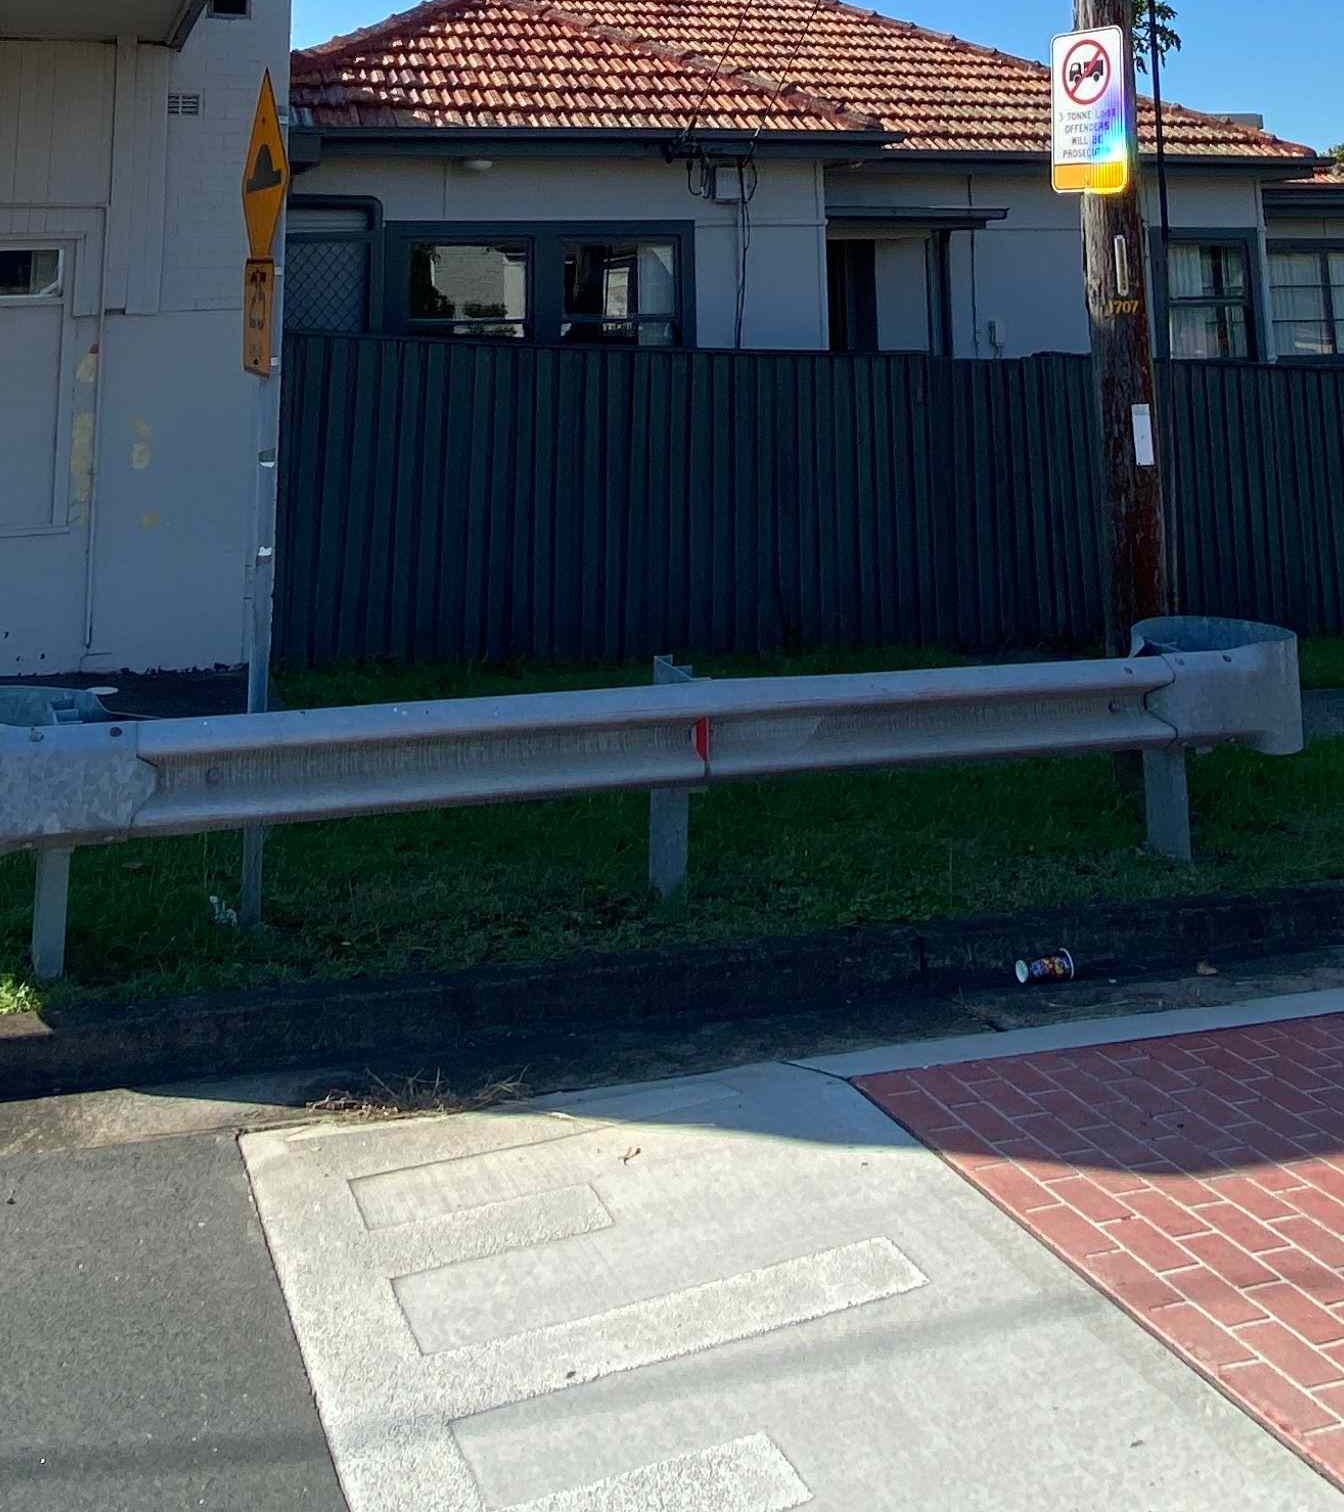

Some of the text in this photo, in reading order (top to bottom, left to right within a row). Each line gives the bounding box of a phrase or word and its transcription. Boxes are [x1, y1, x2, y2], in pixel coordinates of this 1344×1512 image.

[1066, 110, 1092, 120] TONNE
[1065, 121, 1110, 134] OFFENDERS
[1072, 135, 1103, 145] WILL BE
